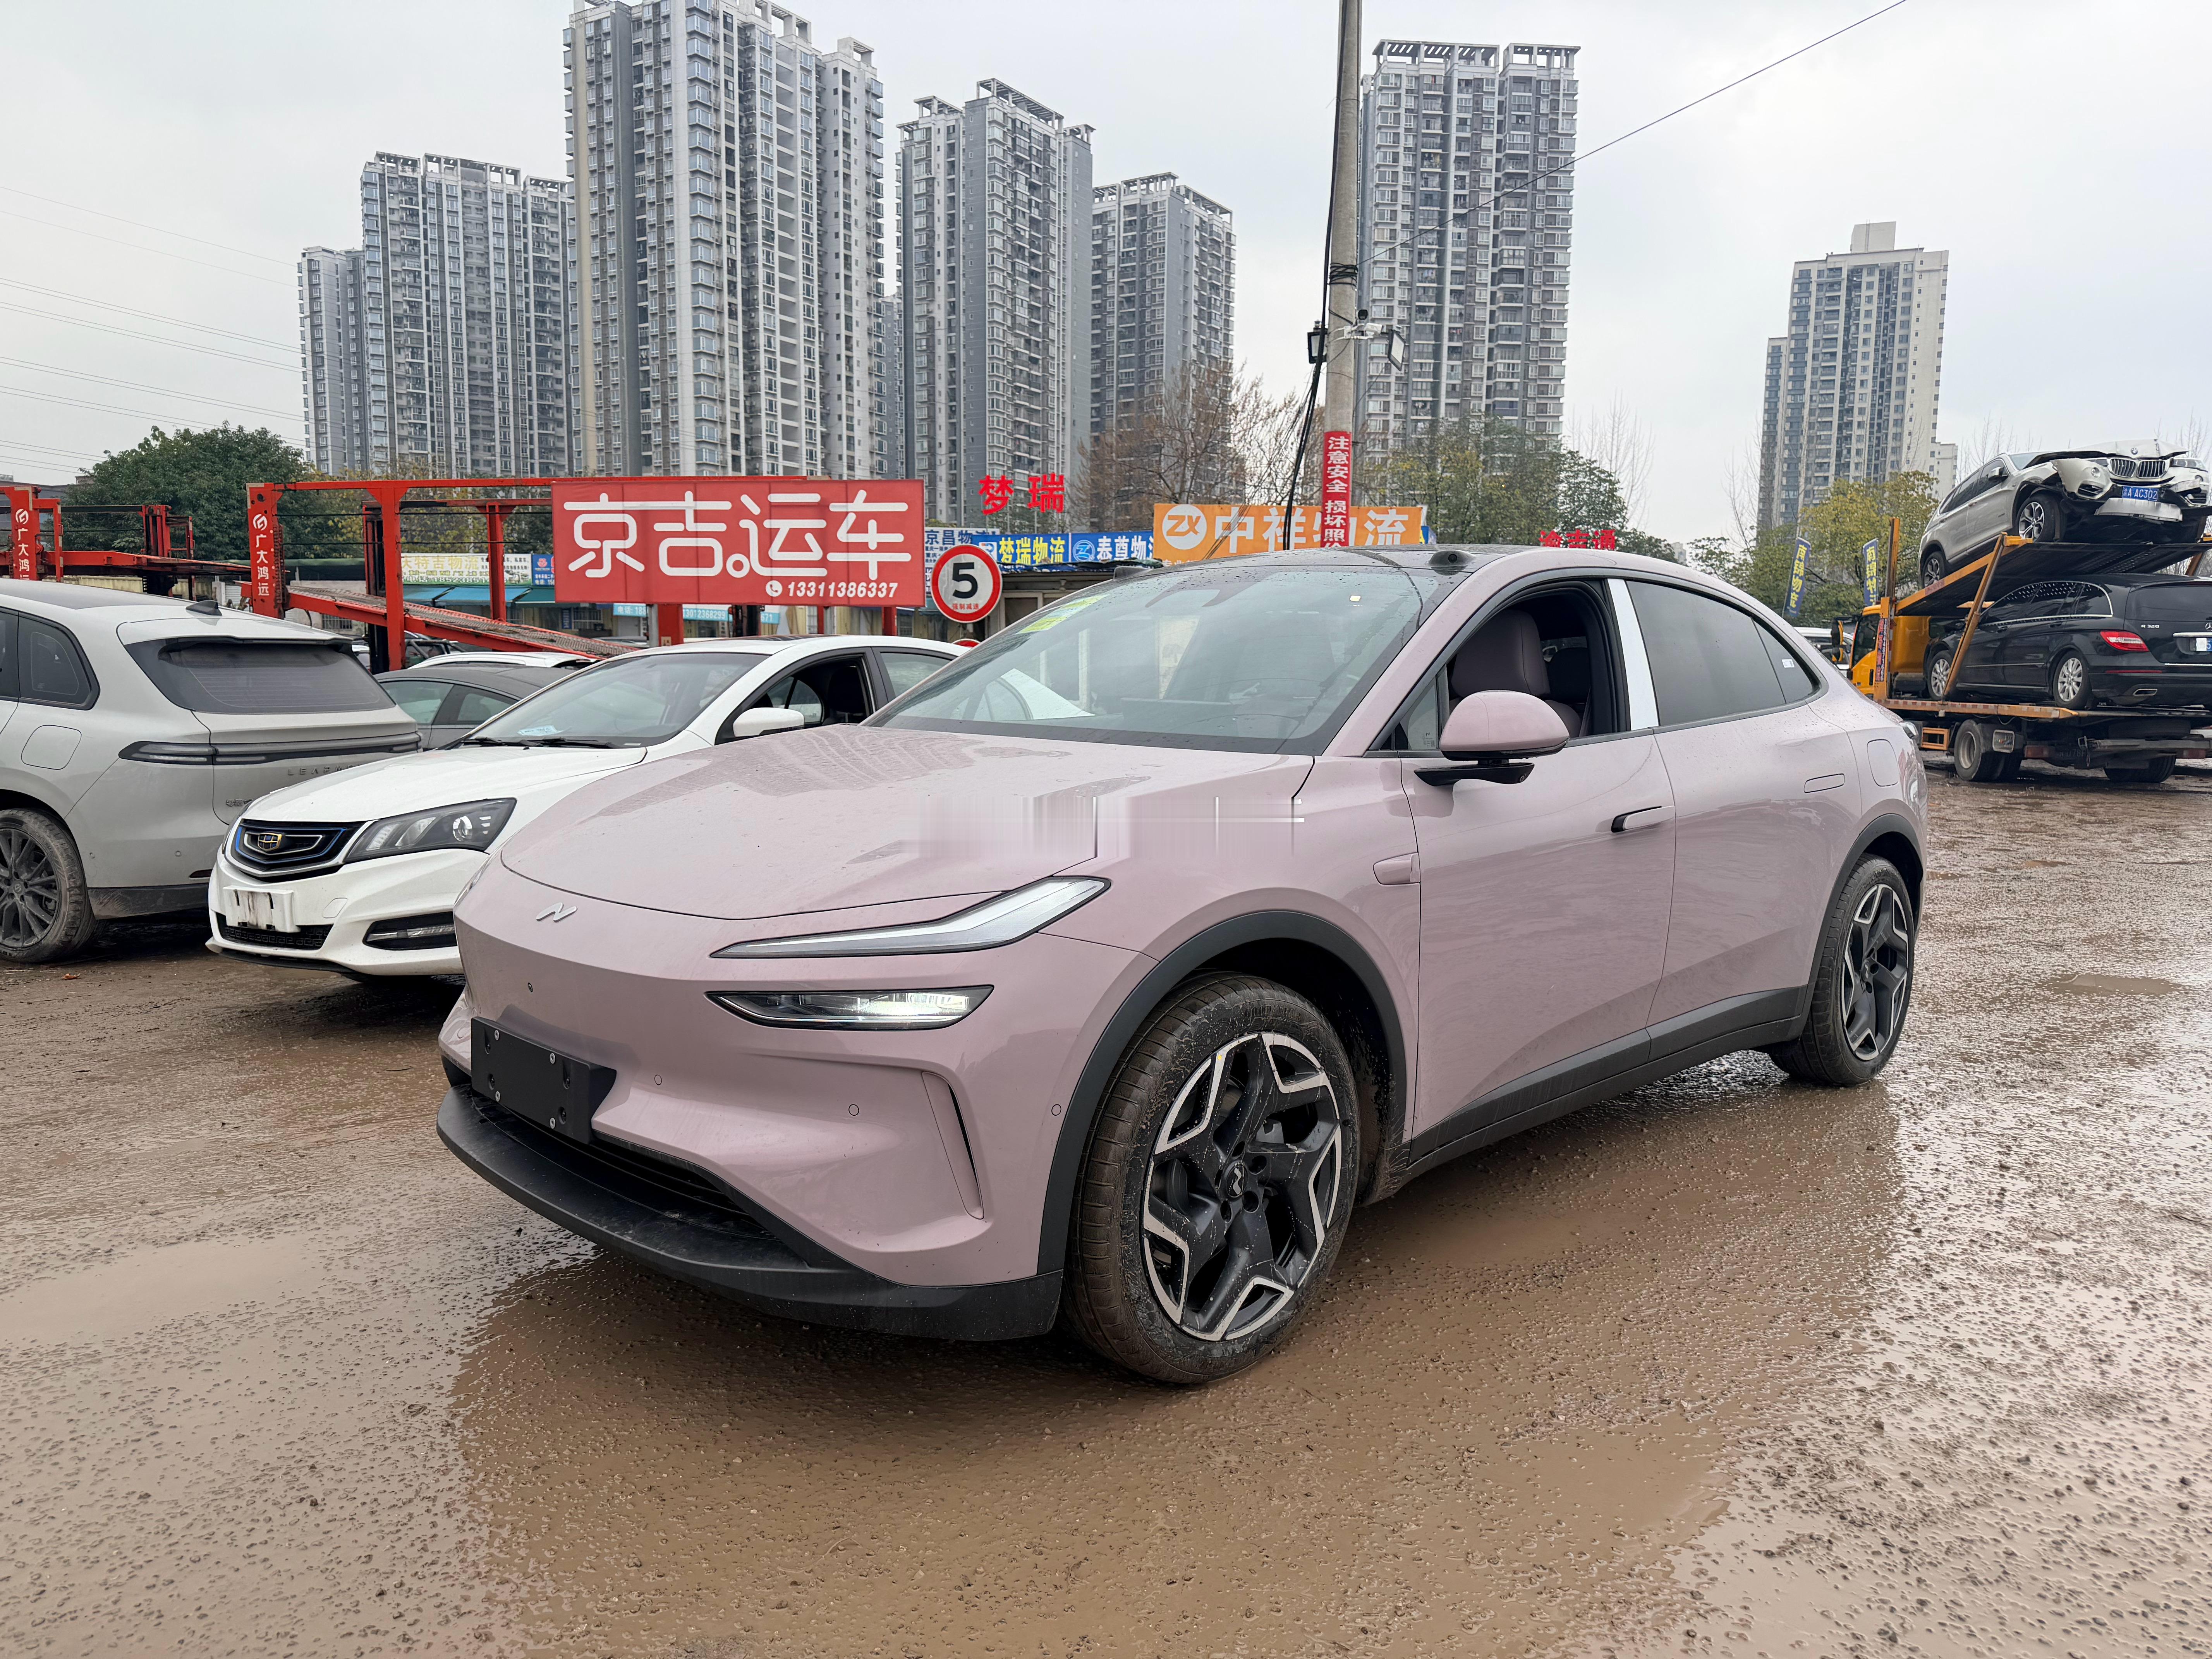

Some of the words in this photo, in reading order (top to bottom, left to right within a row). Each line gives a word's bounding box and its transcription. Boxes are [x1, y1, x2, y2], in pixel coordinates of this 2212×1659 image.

[1326, 436, 1349, 493] 注意安全
[978, 472, 1065, 515] 梦瑞
[2134, 489, 2157, 500] AC302
[925, 529, 997, 545] 京昌物
[1215, 506, 1409, 554] 中祥流
[256, 534, 270, 596] 广大鸿远
[998, 536, 1065, 565] 梦瑞物流
[788, 581, 898, 598] 13311386337
[952, 562, 978, 599] 5
